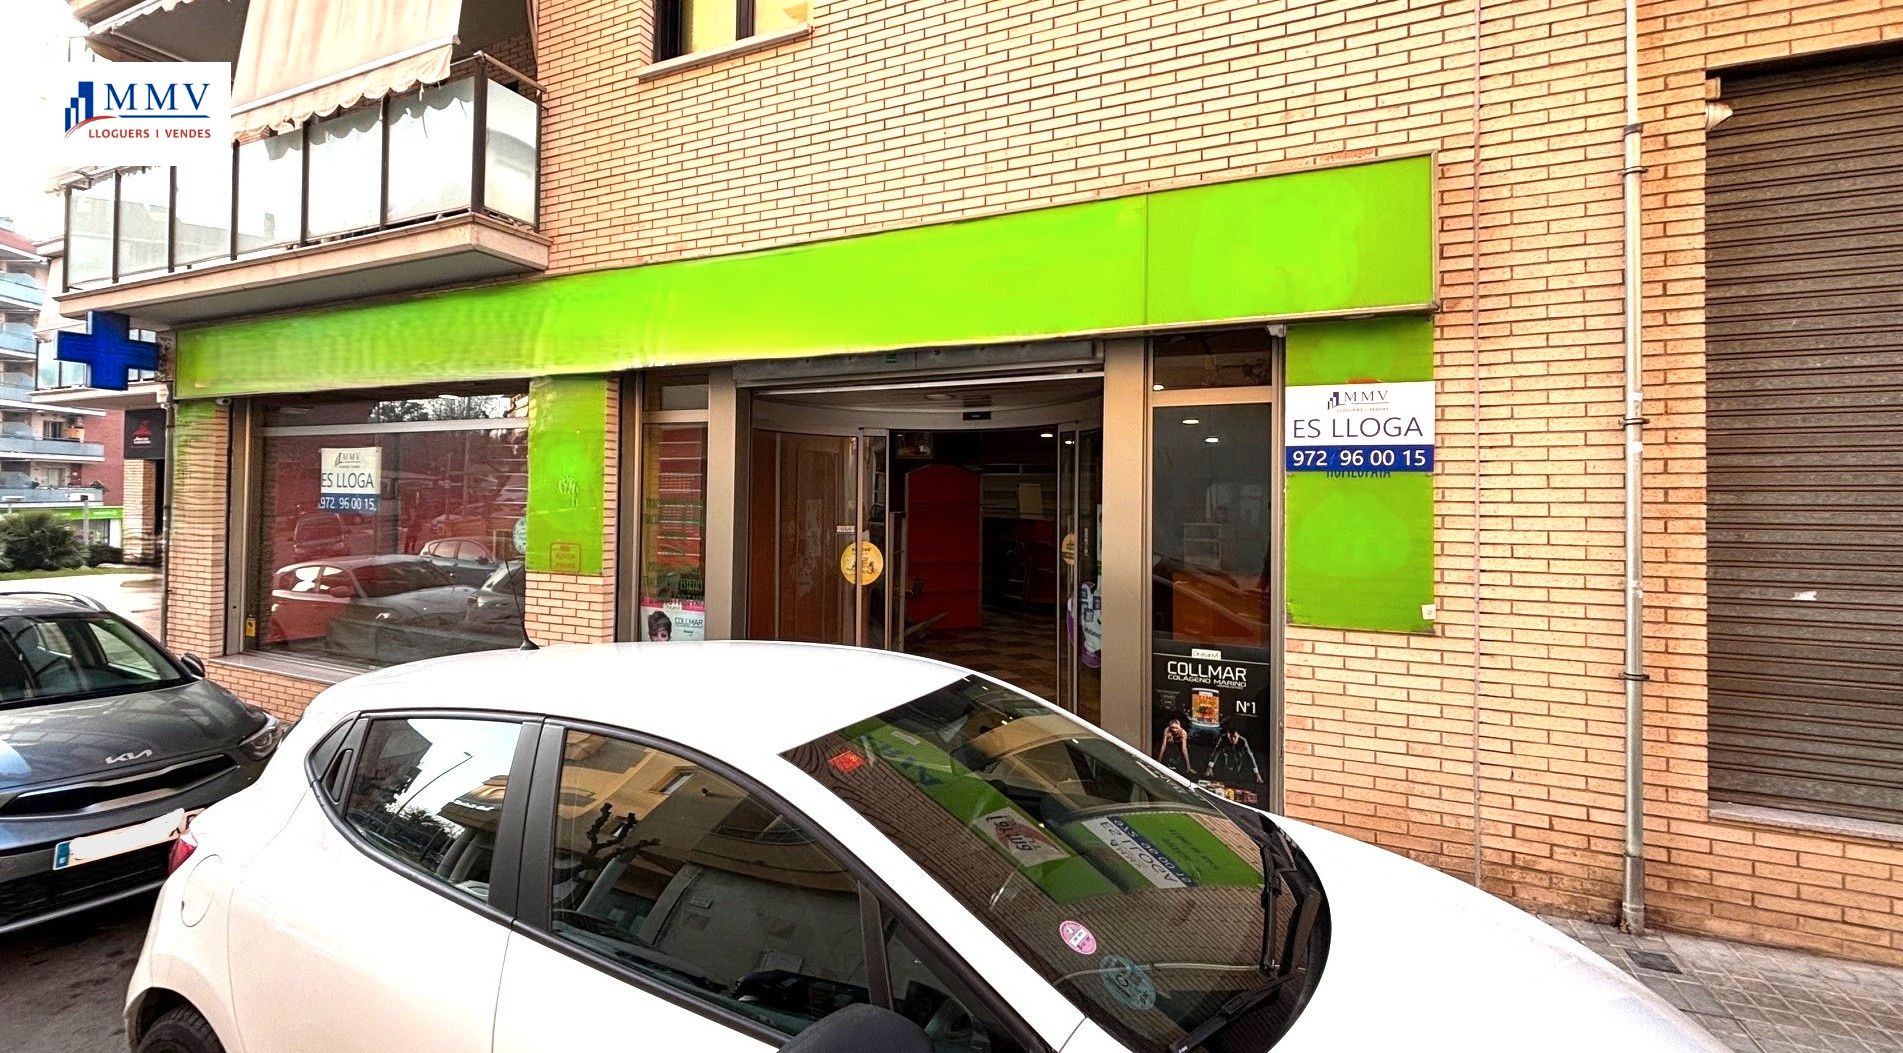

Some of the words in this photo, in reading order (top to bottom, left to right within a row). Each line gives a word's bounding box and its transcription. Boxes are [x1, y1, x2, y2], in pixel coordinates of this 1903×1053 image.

[1344, 390, 1388, 402] MMV
[1293, 419, 1321, 438] ES
[1332, 417, 1423, 438] LLOGA
[1292, 450, 1328, 467] 972
[1340, 450, 1364, 467] 96
[1370, 450, 1395, 467] 00
[1402, 450, 1426, 467] 15
[321, 472, 333, 488] ES
[336, 473, 374, 488] LLOGA
[320, 497, 335, 509] 972
[339, 497, 350, 509] 96
[351, 498, 362, 510] 00
[364, 498, 375, 511] 15
[674, 616, 704, 626] COLLMAR
[1167, 661, 1247, 682] COLLMAR
[1167, 674, 1211, 684] COLAGENO
[1213, 679, 1247, 688] MARINO
